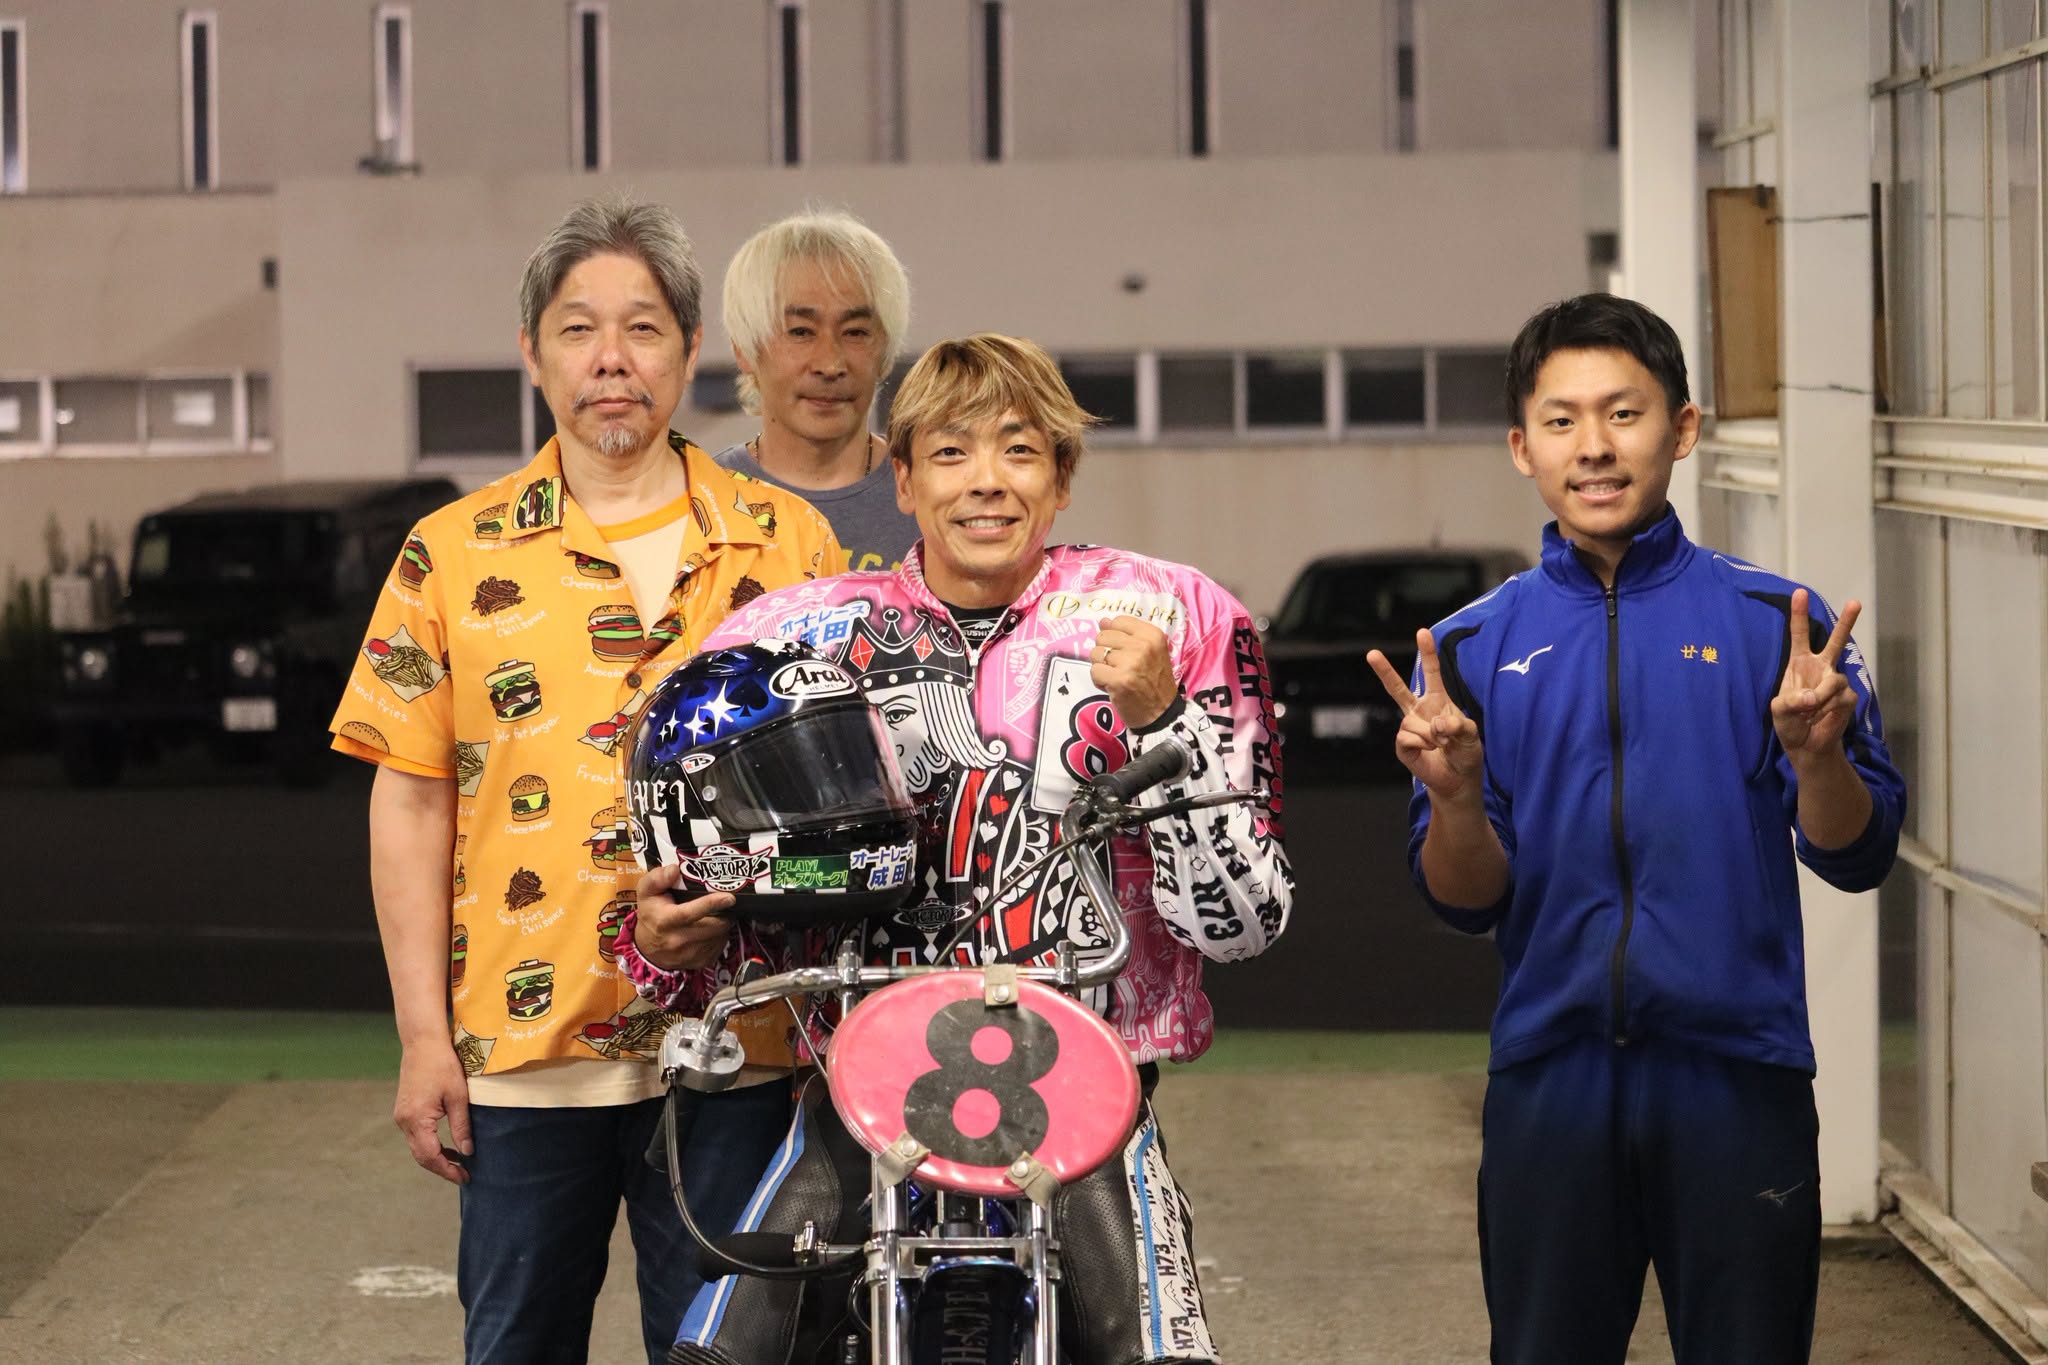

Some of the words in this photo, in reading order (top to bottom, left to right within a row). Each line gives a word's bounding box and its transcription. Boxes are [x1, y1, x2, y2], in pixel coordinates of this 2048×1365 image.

[1088, 599, 1143, 617] Odds
[782, 666, 847, 692] Arai
[576, 764, 617, 786] French
[683, 850, 768, 881] VICTORY
[776, 859, 819, 872] PLAY!
[869, 864, 906, 887] 成田
[1190, 875, 1245, 941] H73
[903, 998, 1060, 1168] 8
[1153, 1243, 1177, 1277] H73
[1169, 1316, 1194, 1350] H73
